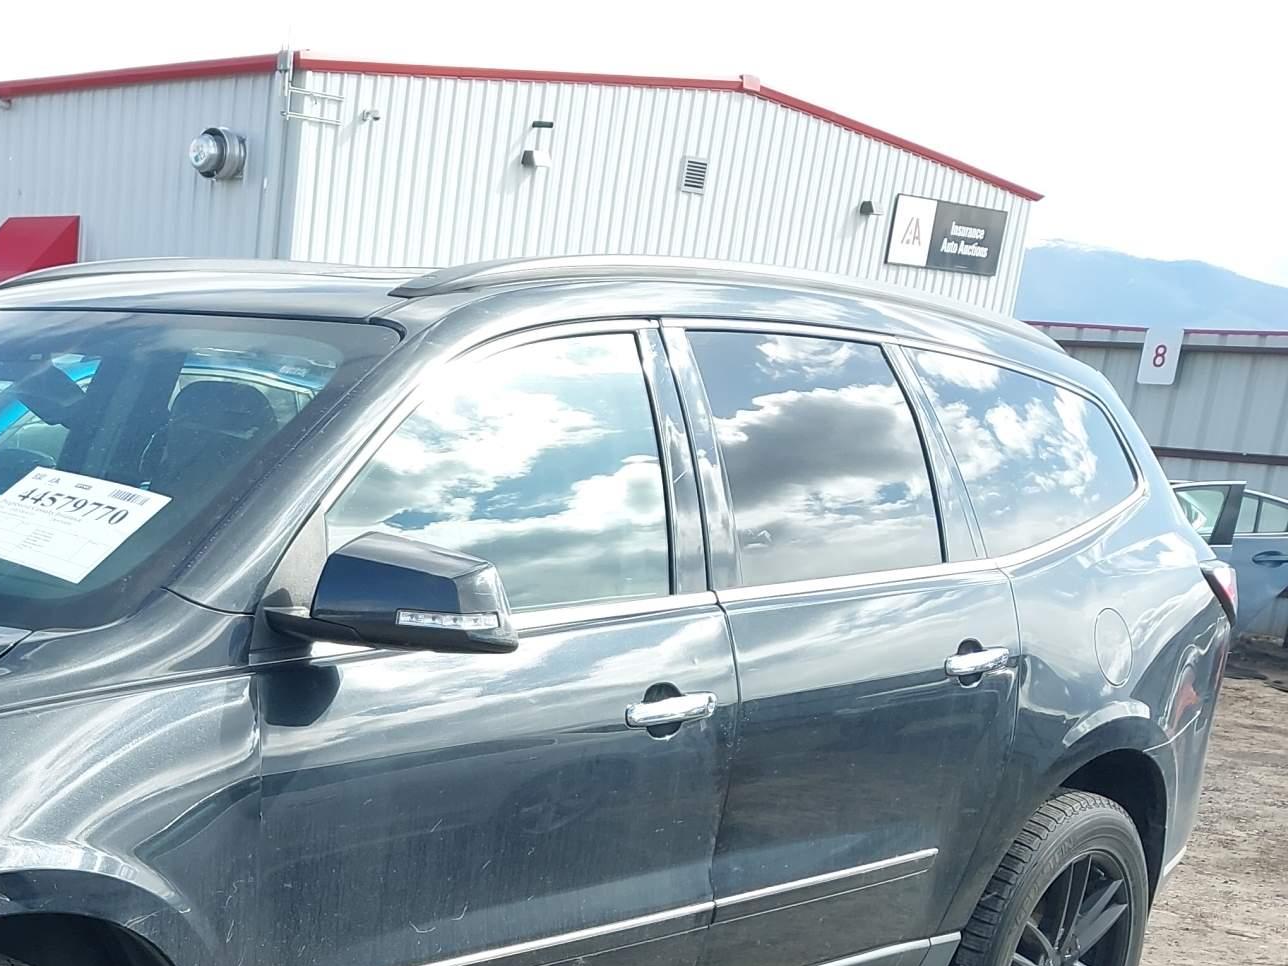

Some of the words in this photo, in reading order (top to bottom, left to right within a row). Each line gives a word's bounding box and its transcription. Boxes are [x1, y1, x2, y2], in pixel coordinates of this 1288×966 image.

[950, 221, 985, 240] Insurance
[940, 238, 958, 254] Auto
[958, 240, 989, 258] Auctions
[1153, 344, 1167, 368] 8
[18, 487, 129, 526] 44579770
